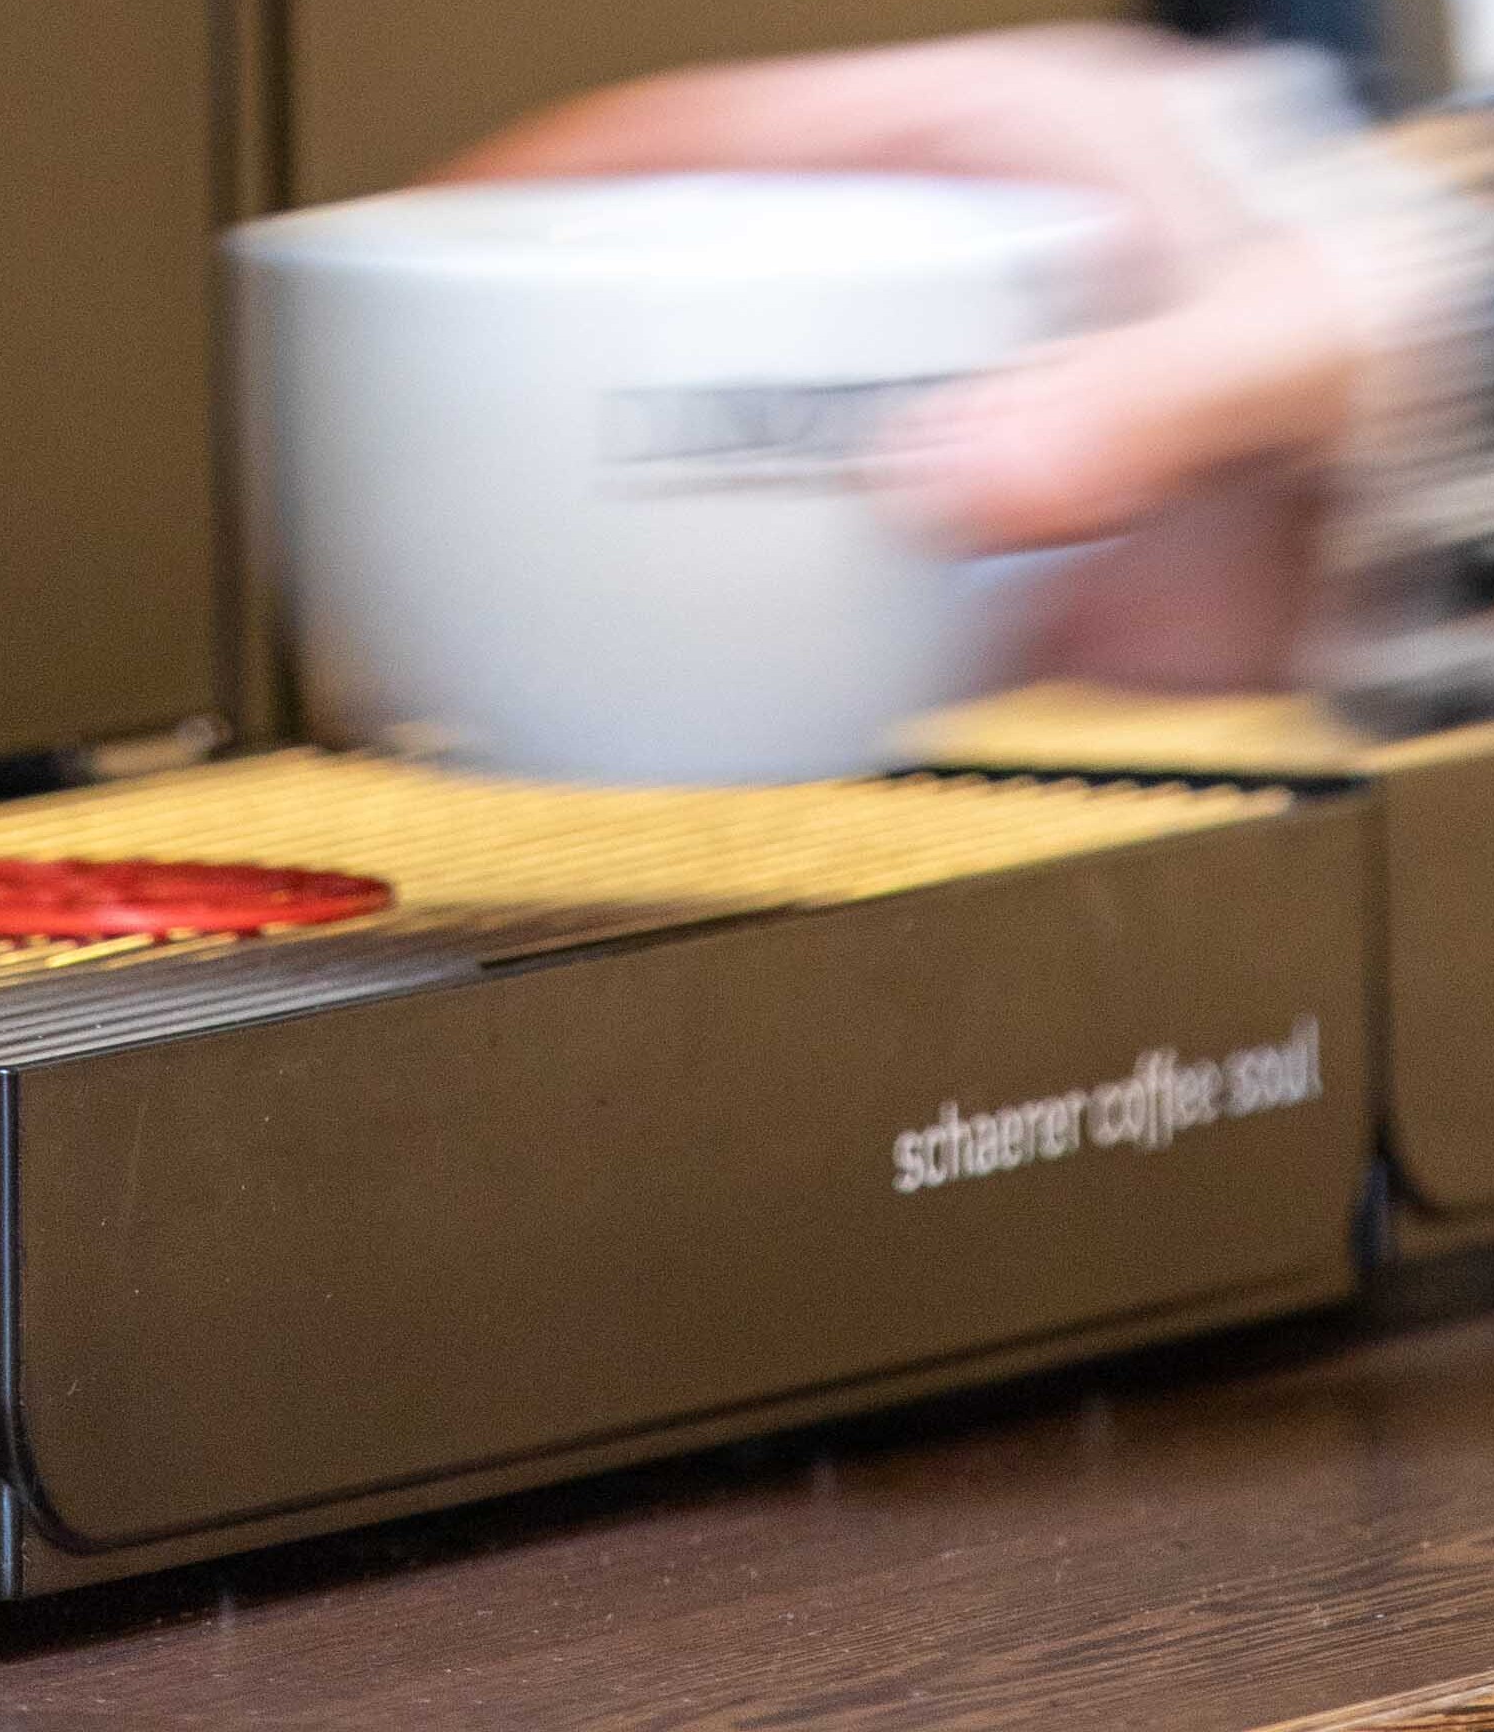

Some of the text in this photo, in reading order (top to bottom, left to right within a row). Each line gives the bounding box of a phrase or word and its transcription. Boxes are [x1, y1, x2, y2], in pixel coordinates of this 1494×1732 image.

[891, 1013, 1323, 1193] schaerer coffee soul
